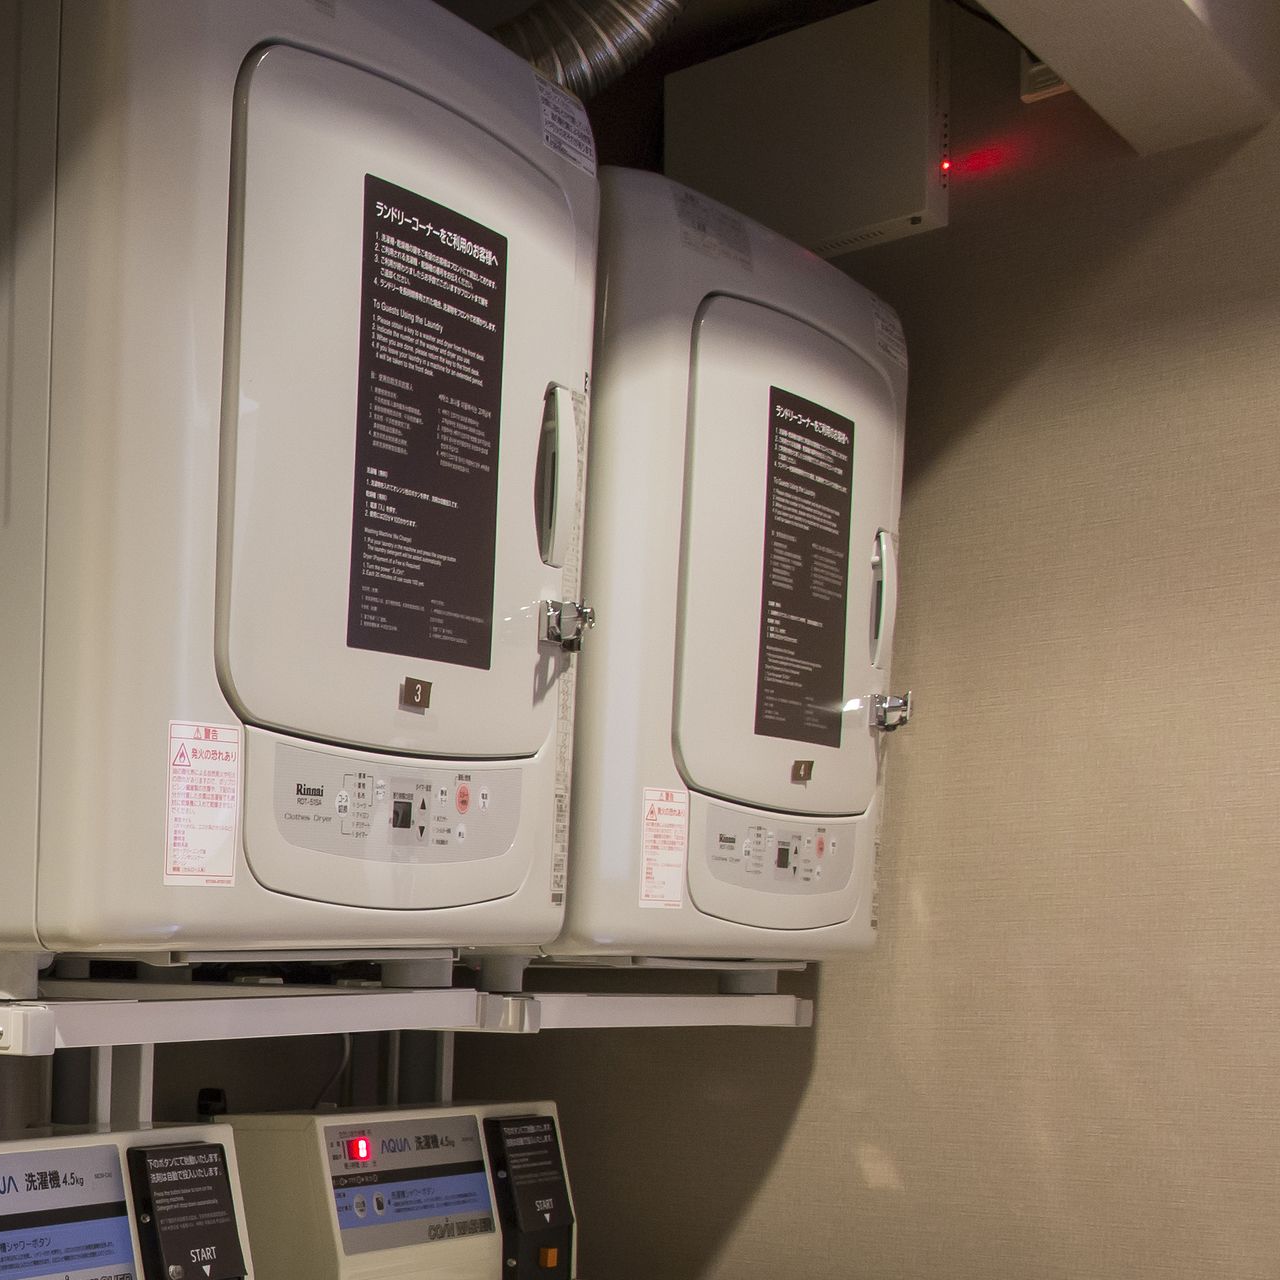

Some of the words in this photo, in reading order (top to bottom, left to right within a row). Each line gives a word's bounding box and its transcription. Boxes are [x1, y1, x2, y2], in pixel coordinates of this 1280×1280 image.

[414, 684, 423, 703] 3
[296, 783, 324, 797] Rinnai
[24, 1170, 61, 1192] 洗濯機
[62, 1172, 85, 1187] 4.5kg
[190, 1247, 217, 1263] START
